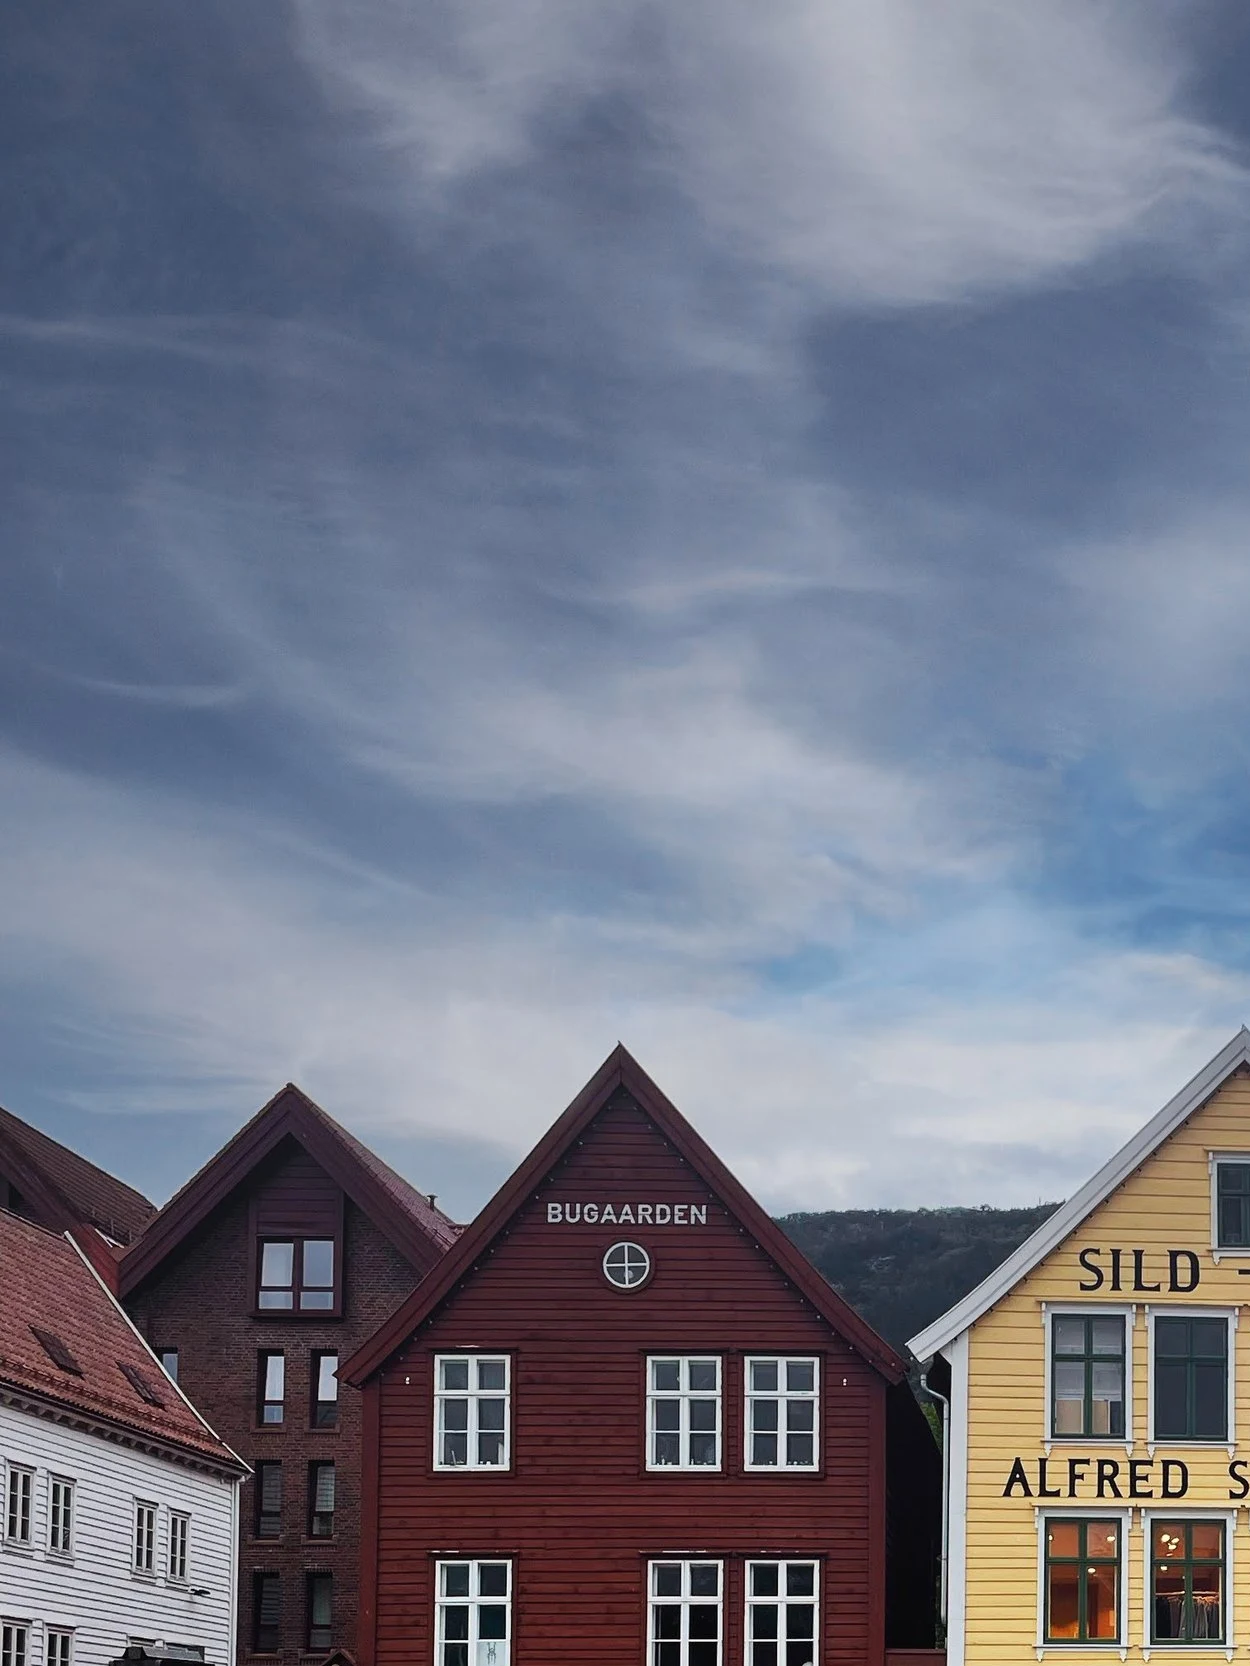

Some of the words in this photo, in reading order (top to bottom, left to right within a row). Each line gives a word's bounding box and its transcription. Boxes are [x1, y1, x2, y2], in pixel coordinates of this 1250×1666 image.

[547, 1203, 707, 1225] BUGAARDEN
[1079, 1248, 1200, 1293] SILD
[1002, 1457, 1189, 1498] ALFRED
